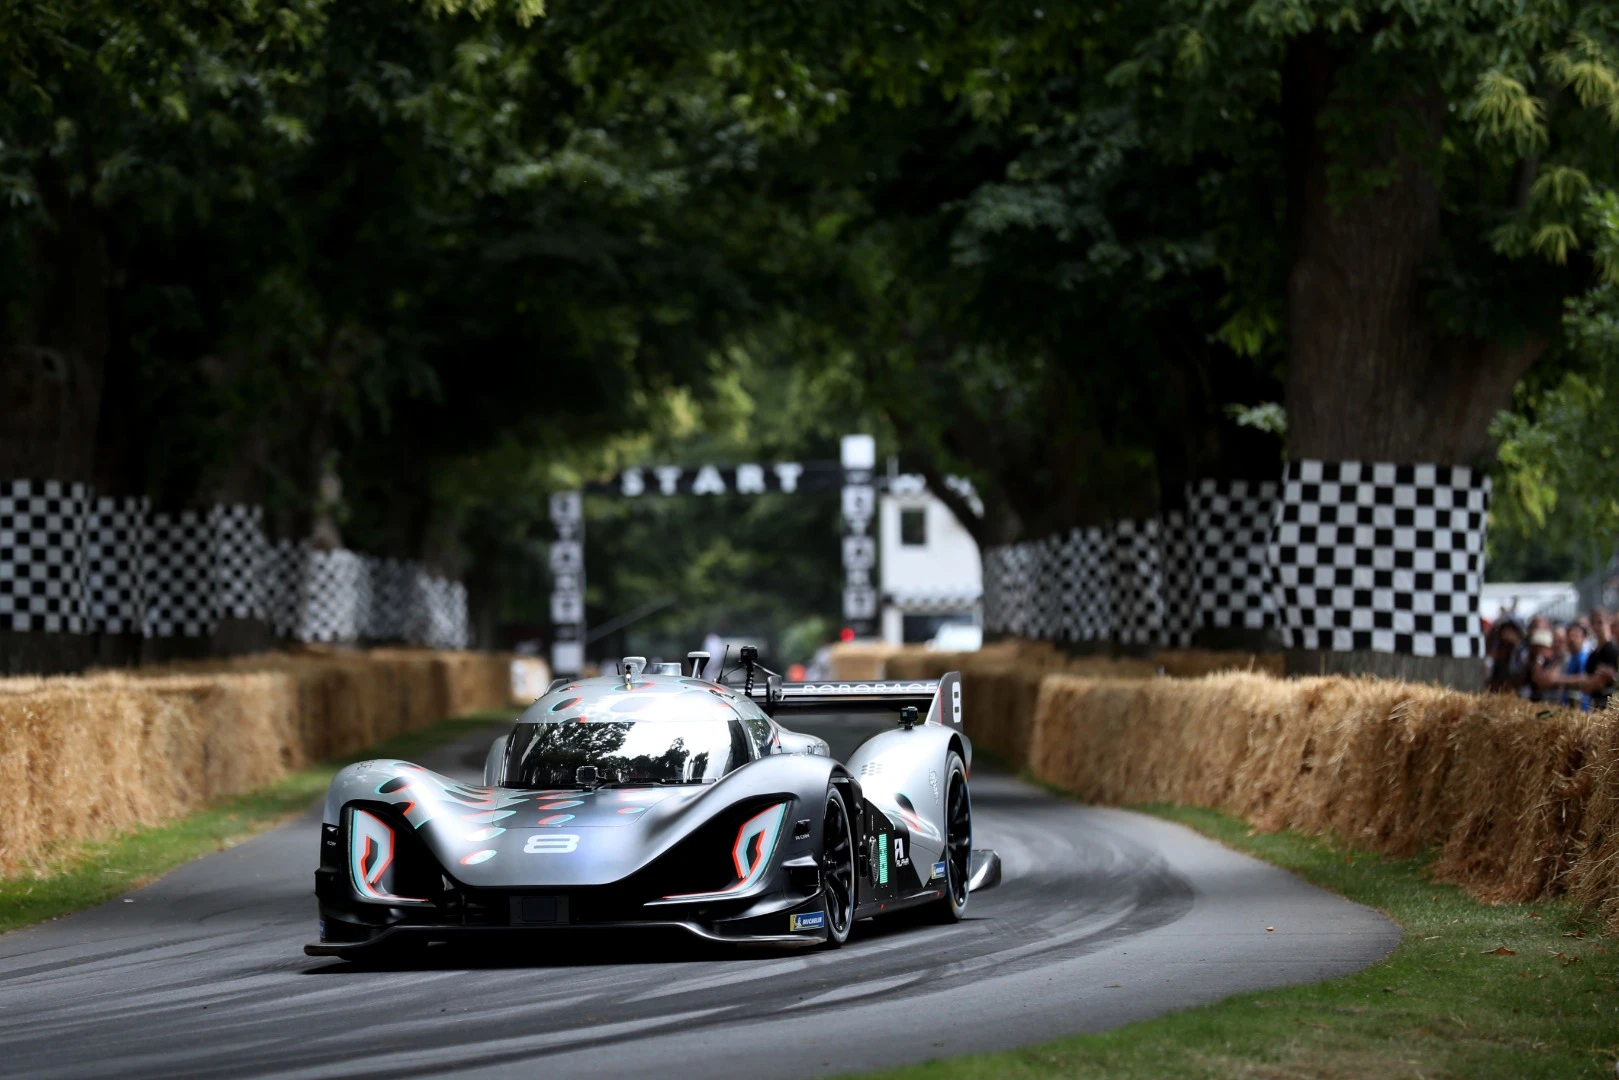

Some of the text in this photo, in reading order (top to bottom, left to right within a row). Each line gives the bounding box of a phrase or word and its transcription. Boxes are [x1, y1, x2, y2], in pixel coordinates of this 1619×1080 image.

[621, 463, 803, 496] START
[952, 682, 962, 723] 8
[523, 834, 579, 854] 8
